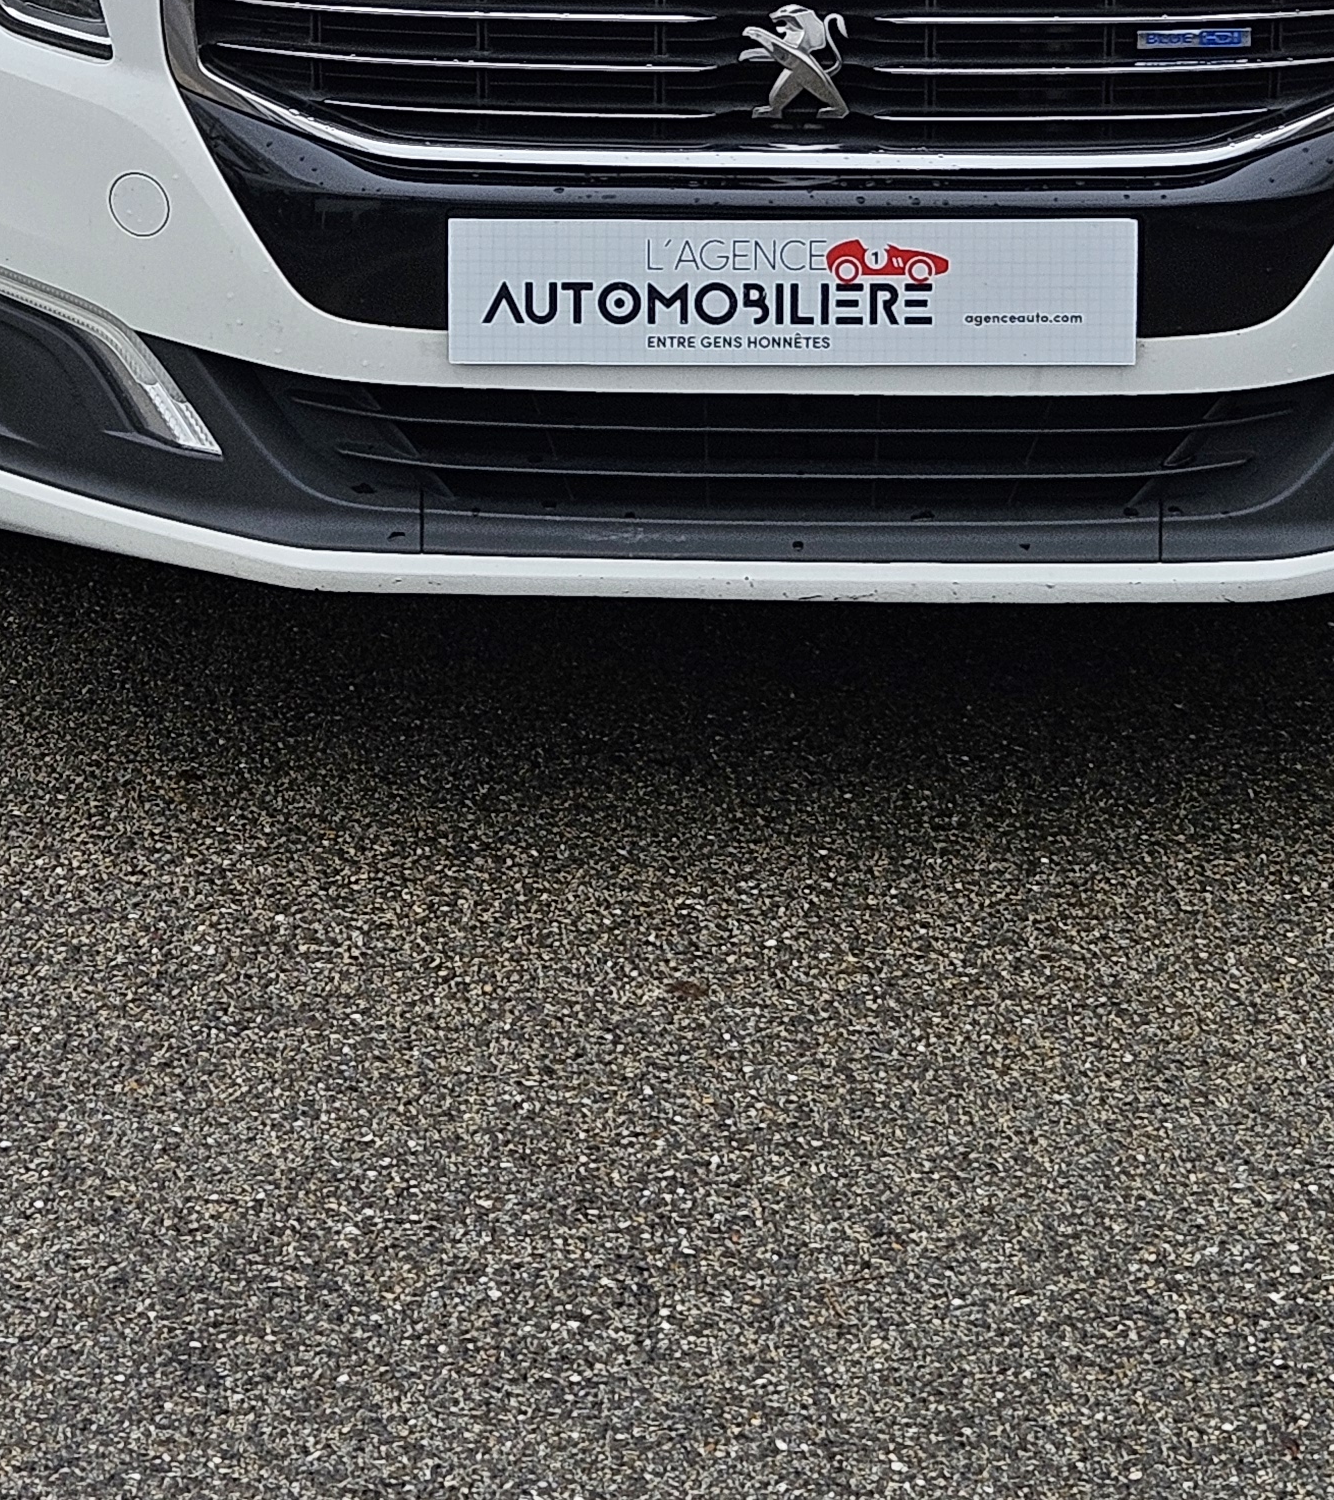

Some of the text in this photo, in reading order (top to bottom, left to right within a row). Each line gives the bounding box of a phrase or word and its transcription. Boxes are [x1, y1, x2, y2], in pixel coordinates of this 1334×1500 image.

[646, 238, 827, 271] L'AGENCE
[964, 311, 1084, 327] agenceauto.com
[646, 331, 832, 351] ENTRE GENS HONNÊTES
